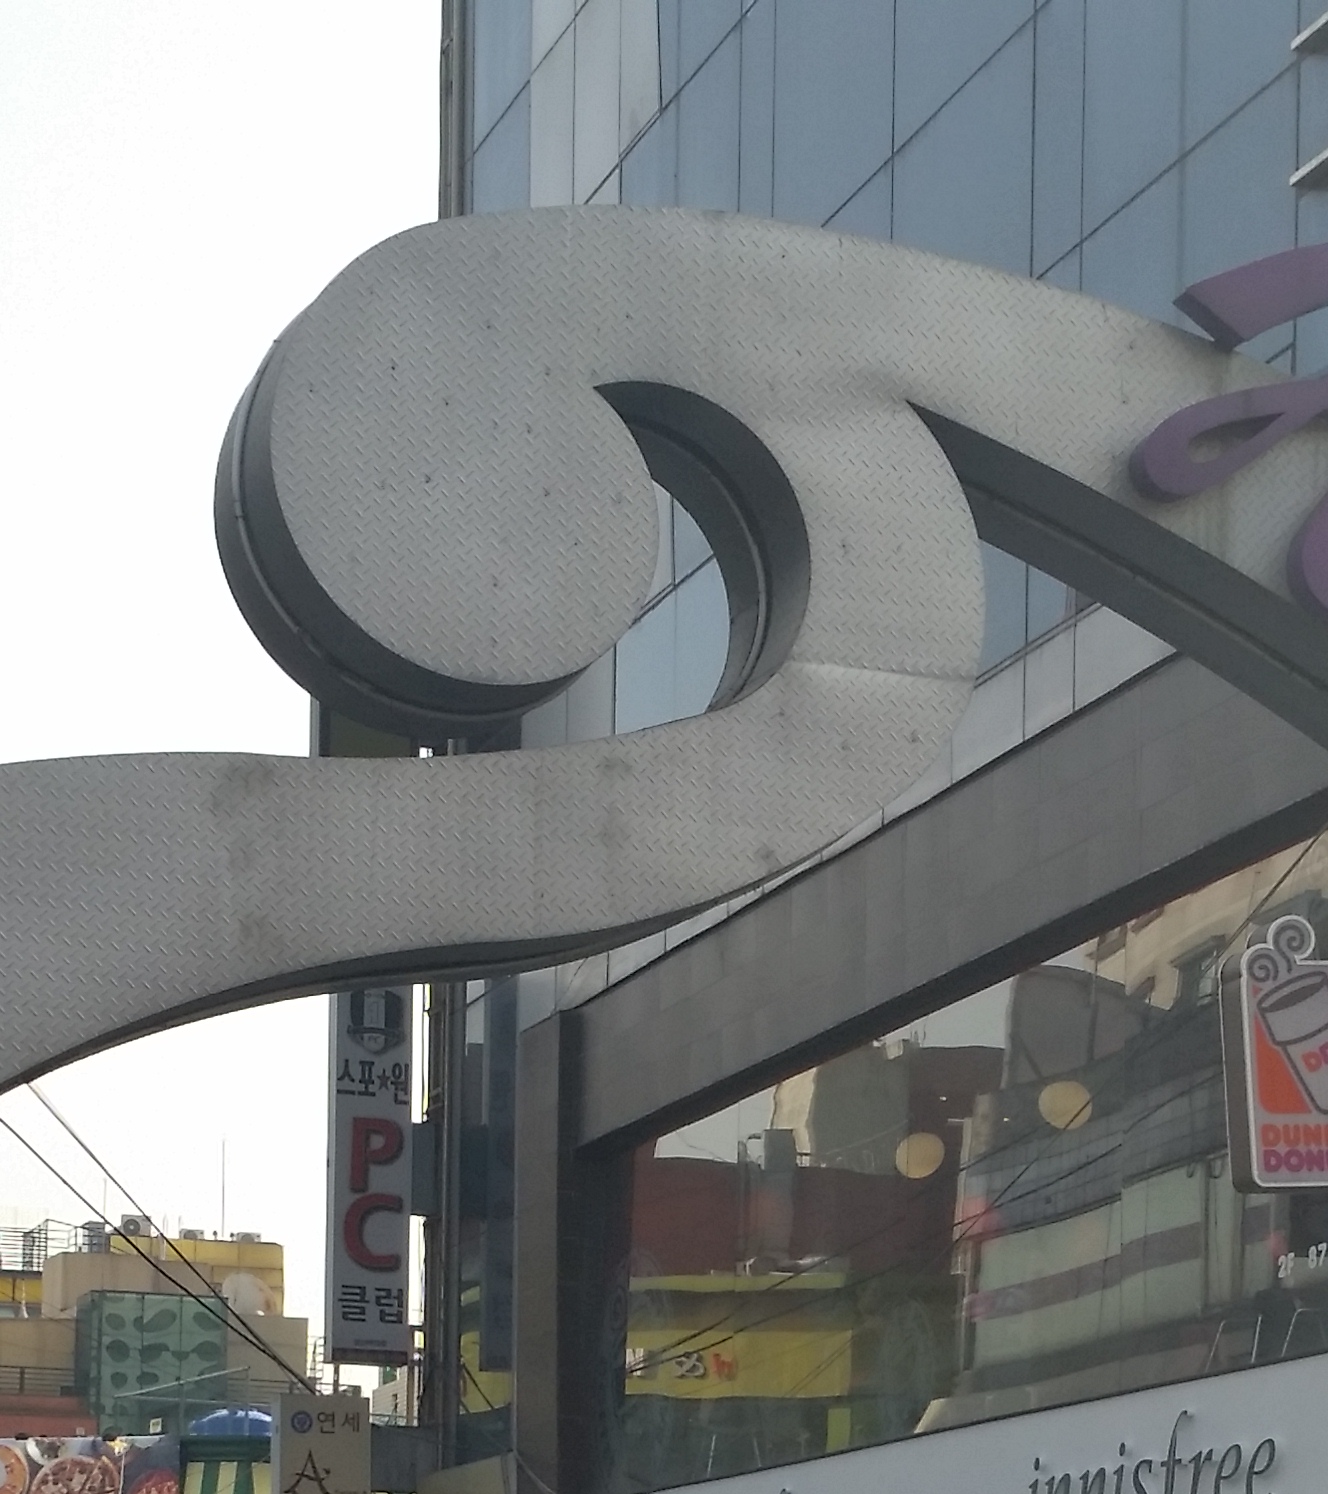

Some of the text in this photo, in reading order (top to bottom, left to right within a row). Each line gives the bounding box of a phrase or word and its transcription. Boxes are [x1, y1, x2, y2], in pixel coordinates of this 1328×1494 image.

[343, 1116, 404, 1273] PC
[337, 1284, 404, 1324] 클럽
[317, 1411, 360, 1434] 연세
